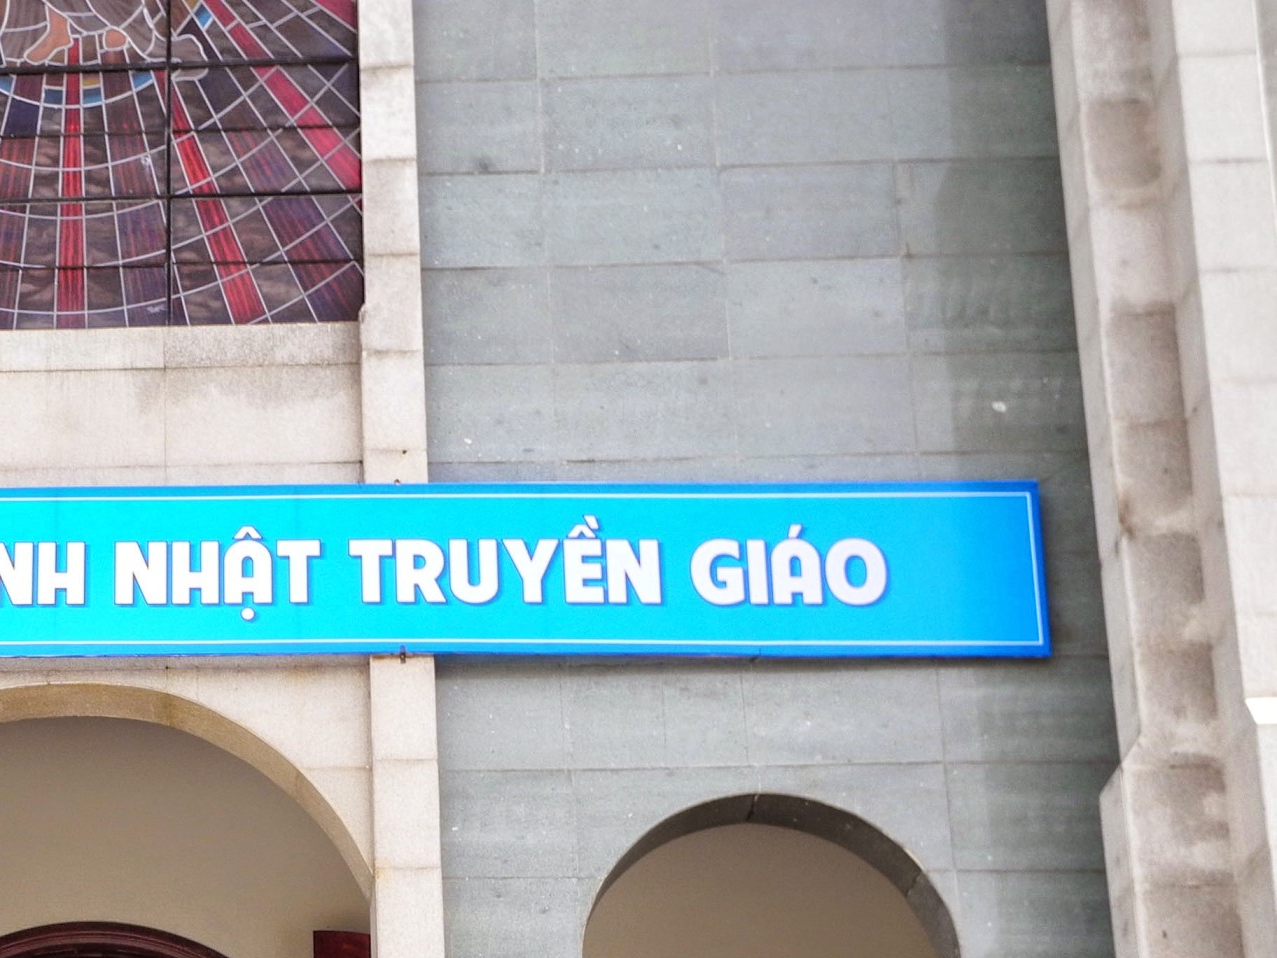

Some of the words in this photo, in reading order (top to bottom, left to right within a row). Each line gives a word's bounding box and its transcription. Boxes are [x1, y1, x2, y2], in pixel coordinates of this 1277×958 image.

[113, 524, 323, 621] NHẬT
[347, 514, 662, 606] TRUYỀN
[691, 522, 889, 607] GIÁO
